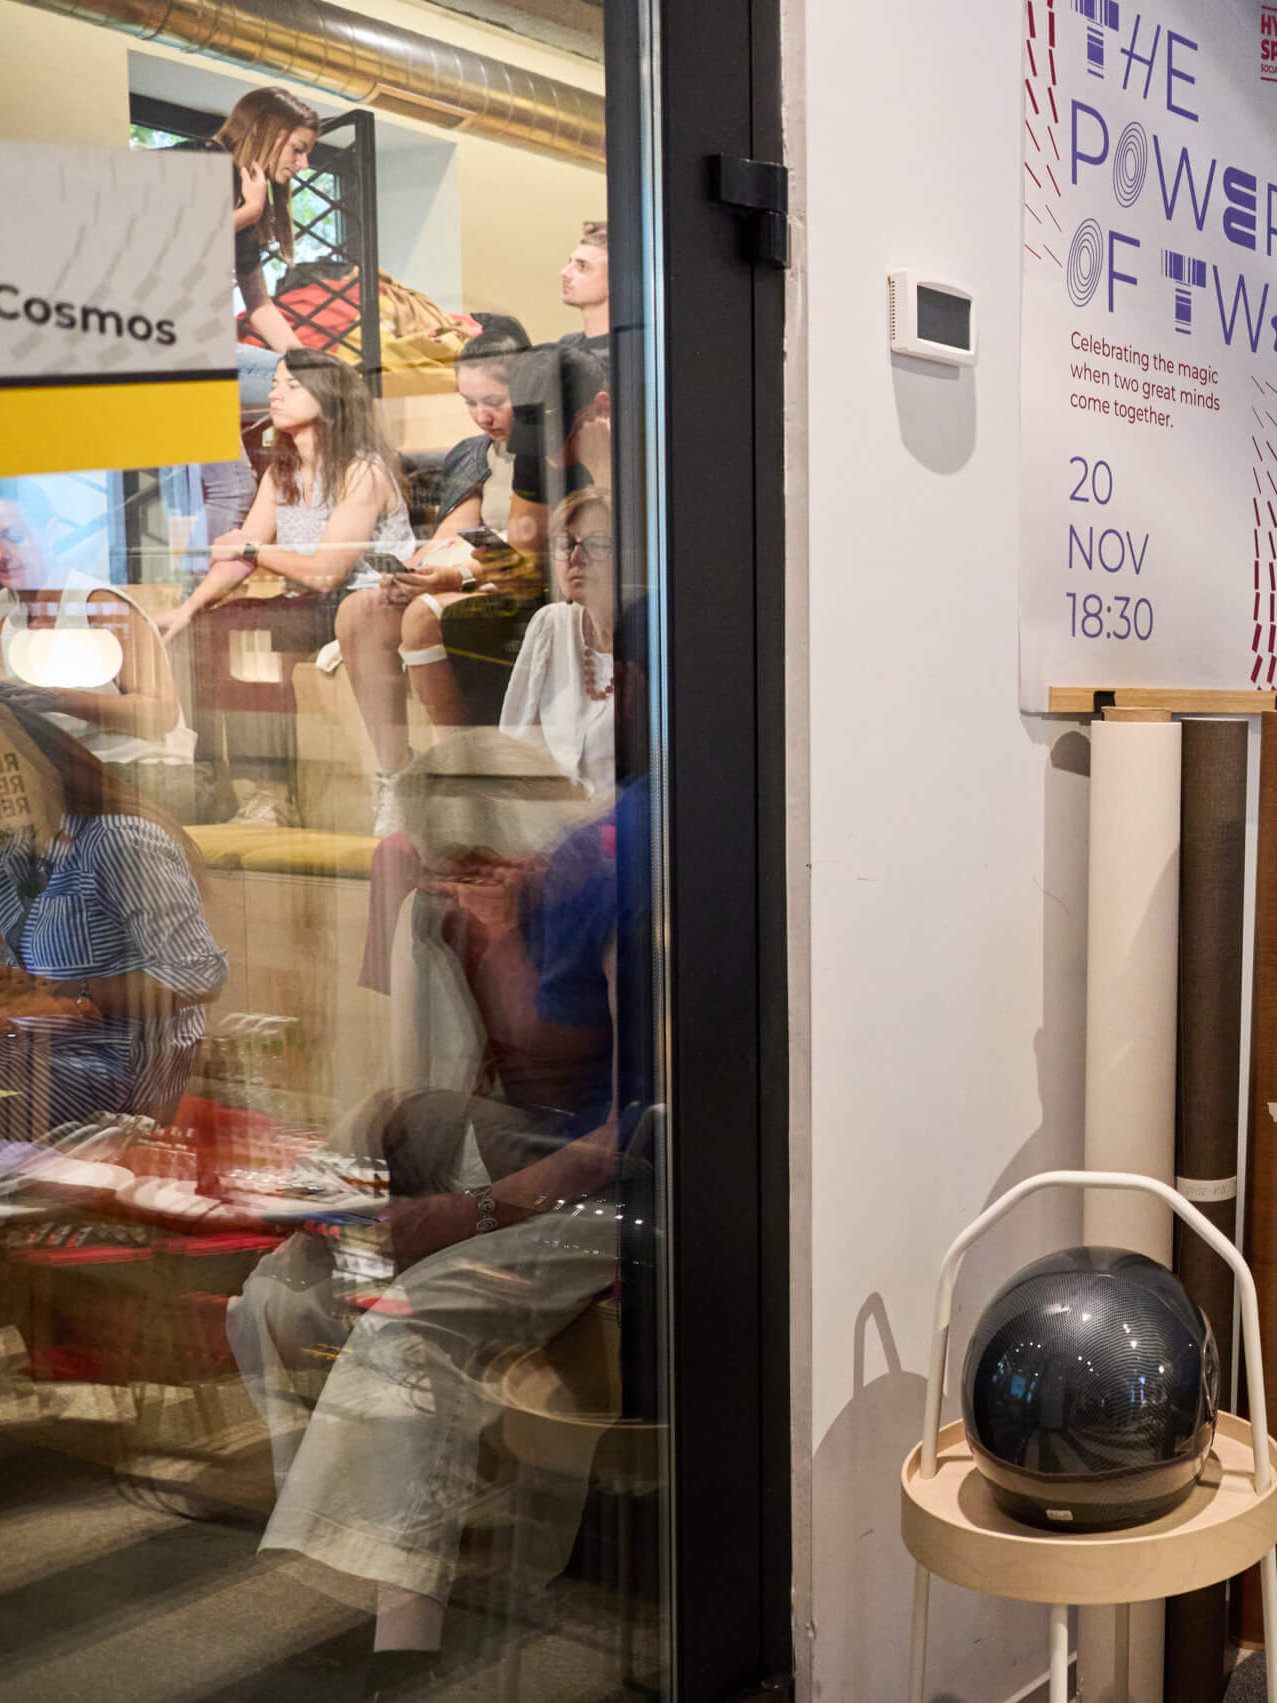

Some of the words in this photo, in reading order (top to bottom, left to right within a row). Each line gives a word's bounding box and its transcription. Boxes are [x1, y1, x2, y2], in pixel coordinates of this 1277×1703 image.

[1070, 0, 1199, 123] THE
[1066, 217, 1141, 313] OF
[0, 284, 177, 346] Cosmos
[1070, 331, 1149, 371] Celebrating
[1153, 353, 1175, 374] the
[1178, 362, 1219, 386] magic
[1070, 362, 1110, 387] when
[1114, 371, 1139, 393] two
[1142, 382, 1176, 401] great
[1180, 388, 1221, 411] minds
[1070, 393, 1110, 414] come
[1114, 399, 1174, 428] together.
[1069, 456, 1113, 505] 20
[1068, 524, 1149, 575] NOV
[1066, 593, 1153, 641] 18:30
